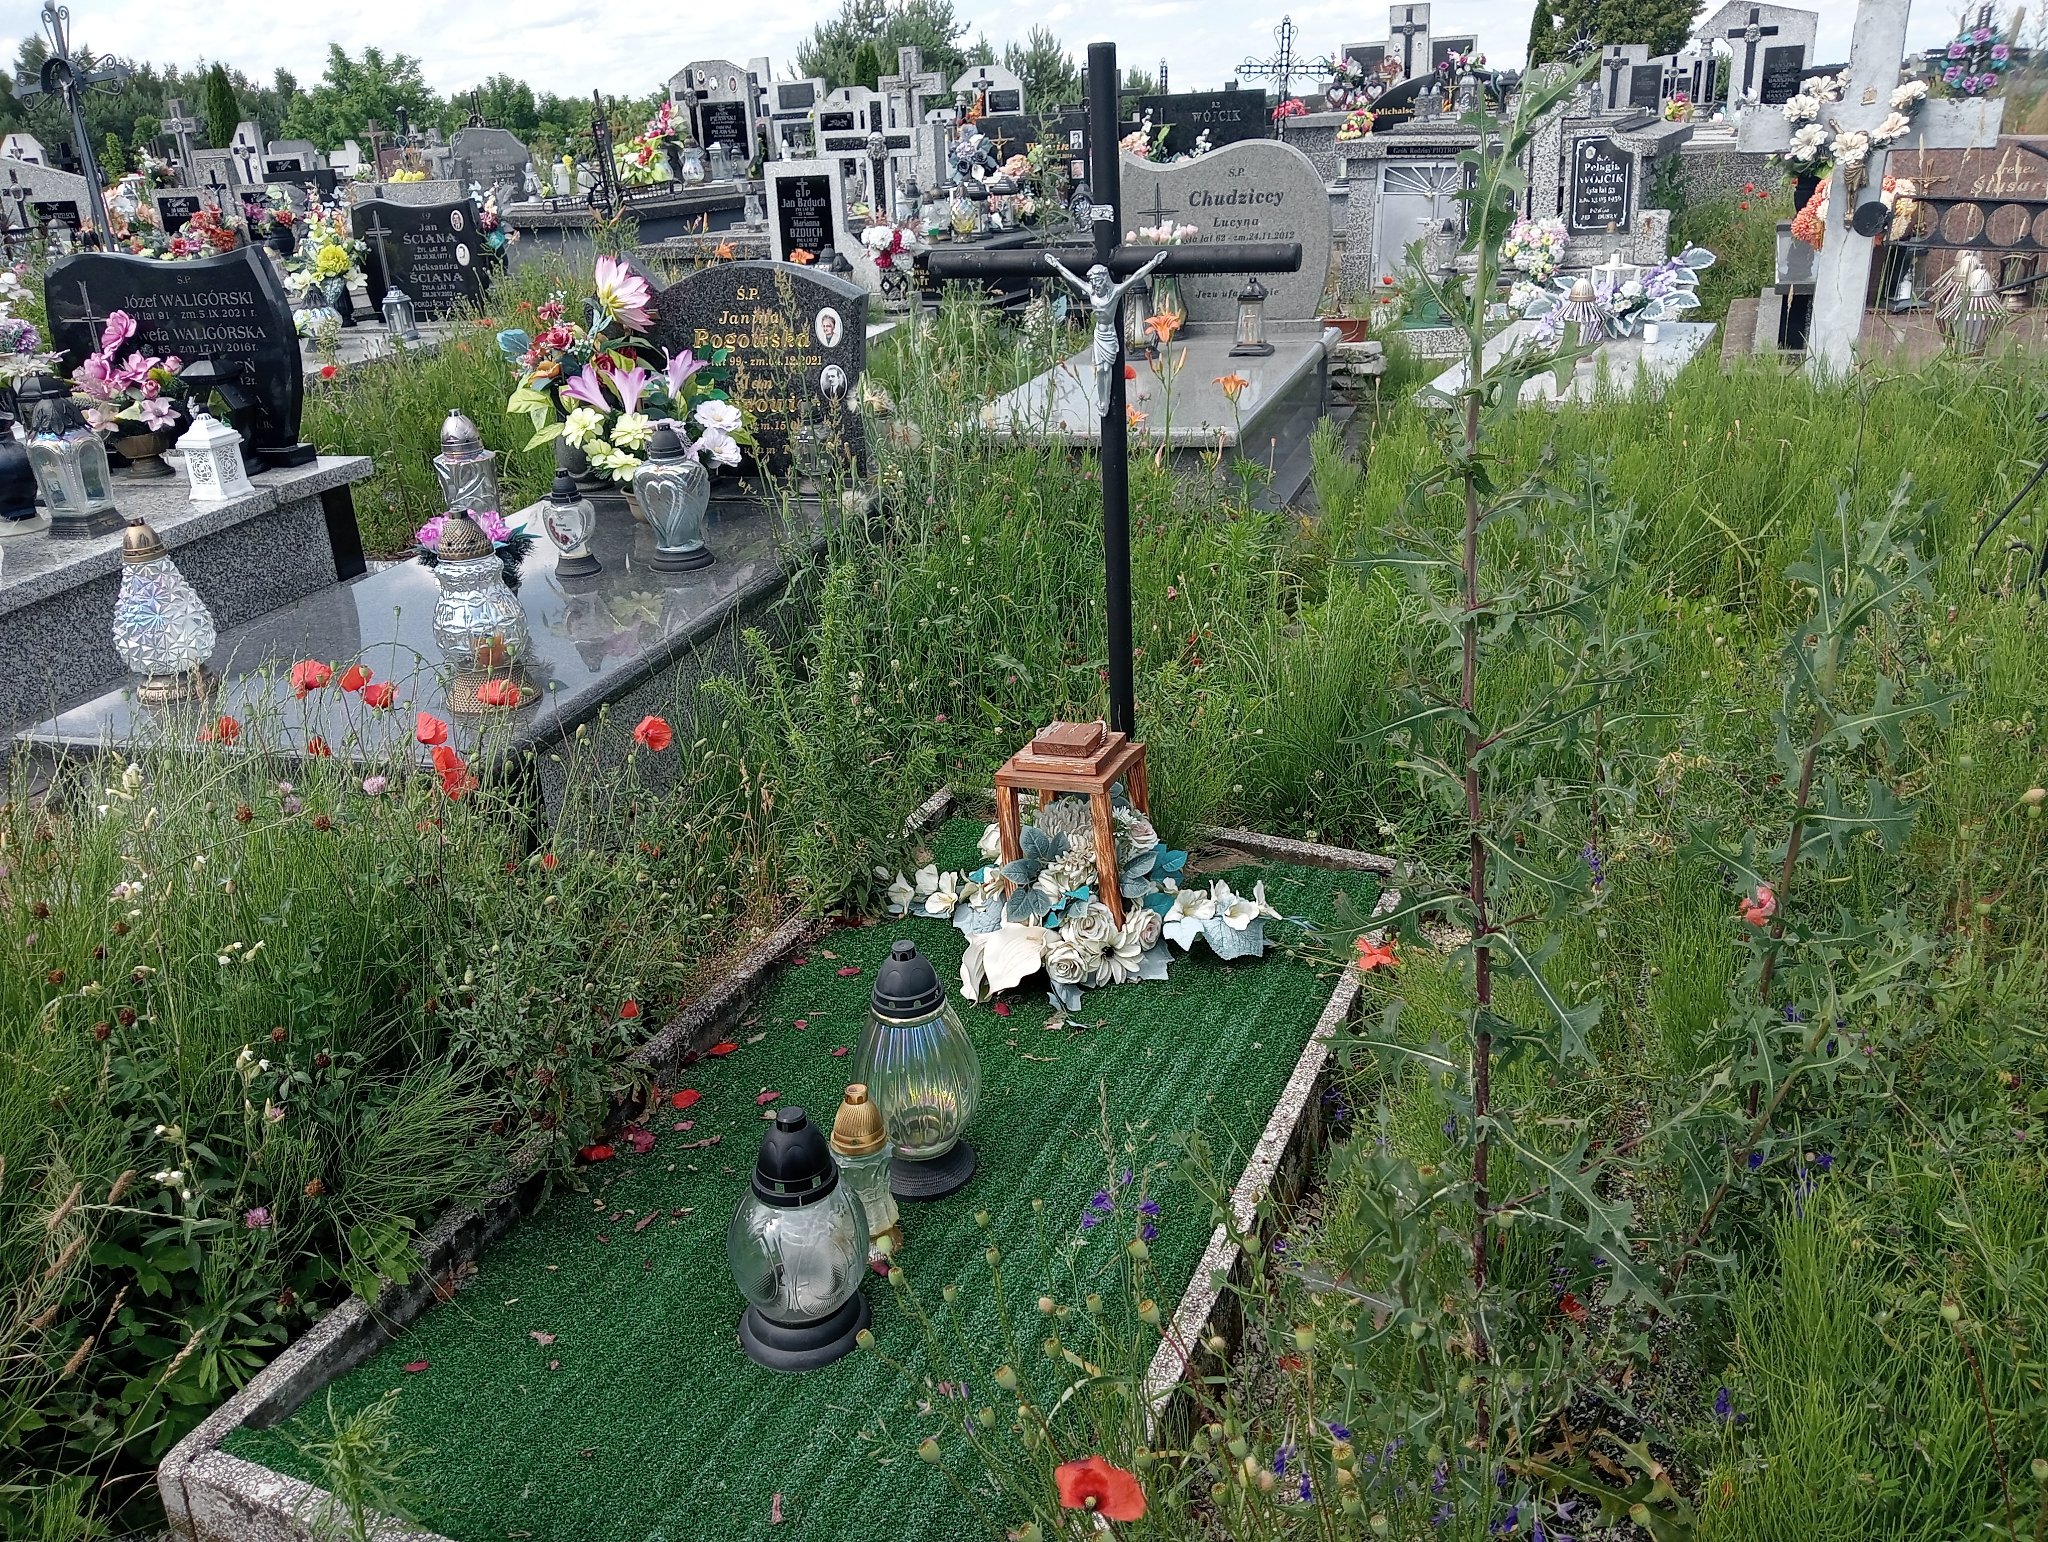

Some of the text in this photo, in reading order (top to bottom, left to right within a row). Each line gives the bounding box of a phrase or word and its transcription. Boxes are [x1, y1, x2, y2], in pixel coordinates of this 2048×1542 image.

[1579, 173, 1624, 184] WÓJCIK
[1189, 188, 1284, 207] Chudziccy
[418, 223, 438, 232] Jan
[402, 233, 458, 246] ŚCIANA
[411, 262, 459, 273] Aleksandra
[409, 272, 464, 284] ŚCIANA
[159, 289, 254, 307] WALIGÓRSKI
[736, 286, 760, 300] Ś.P.
[1221, 288, 1240, 299] ufa
[124, 293, 159, 310] Józef
[157, 310, 171, 321] 91
[173, 324, 267, 341] WALIGÓRSKA
[157, 344, 171, 354] 85
[729, 357, 742, 366] 99
